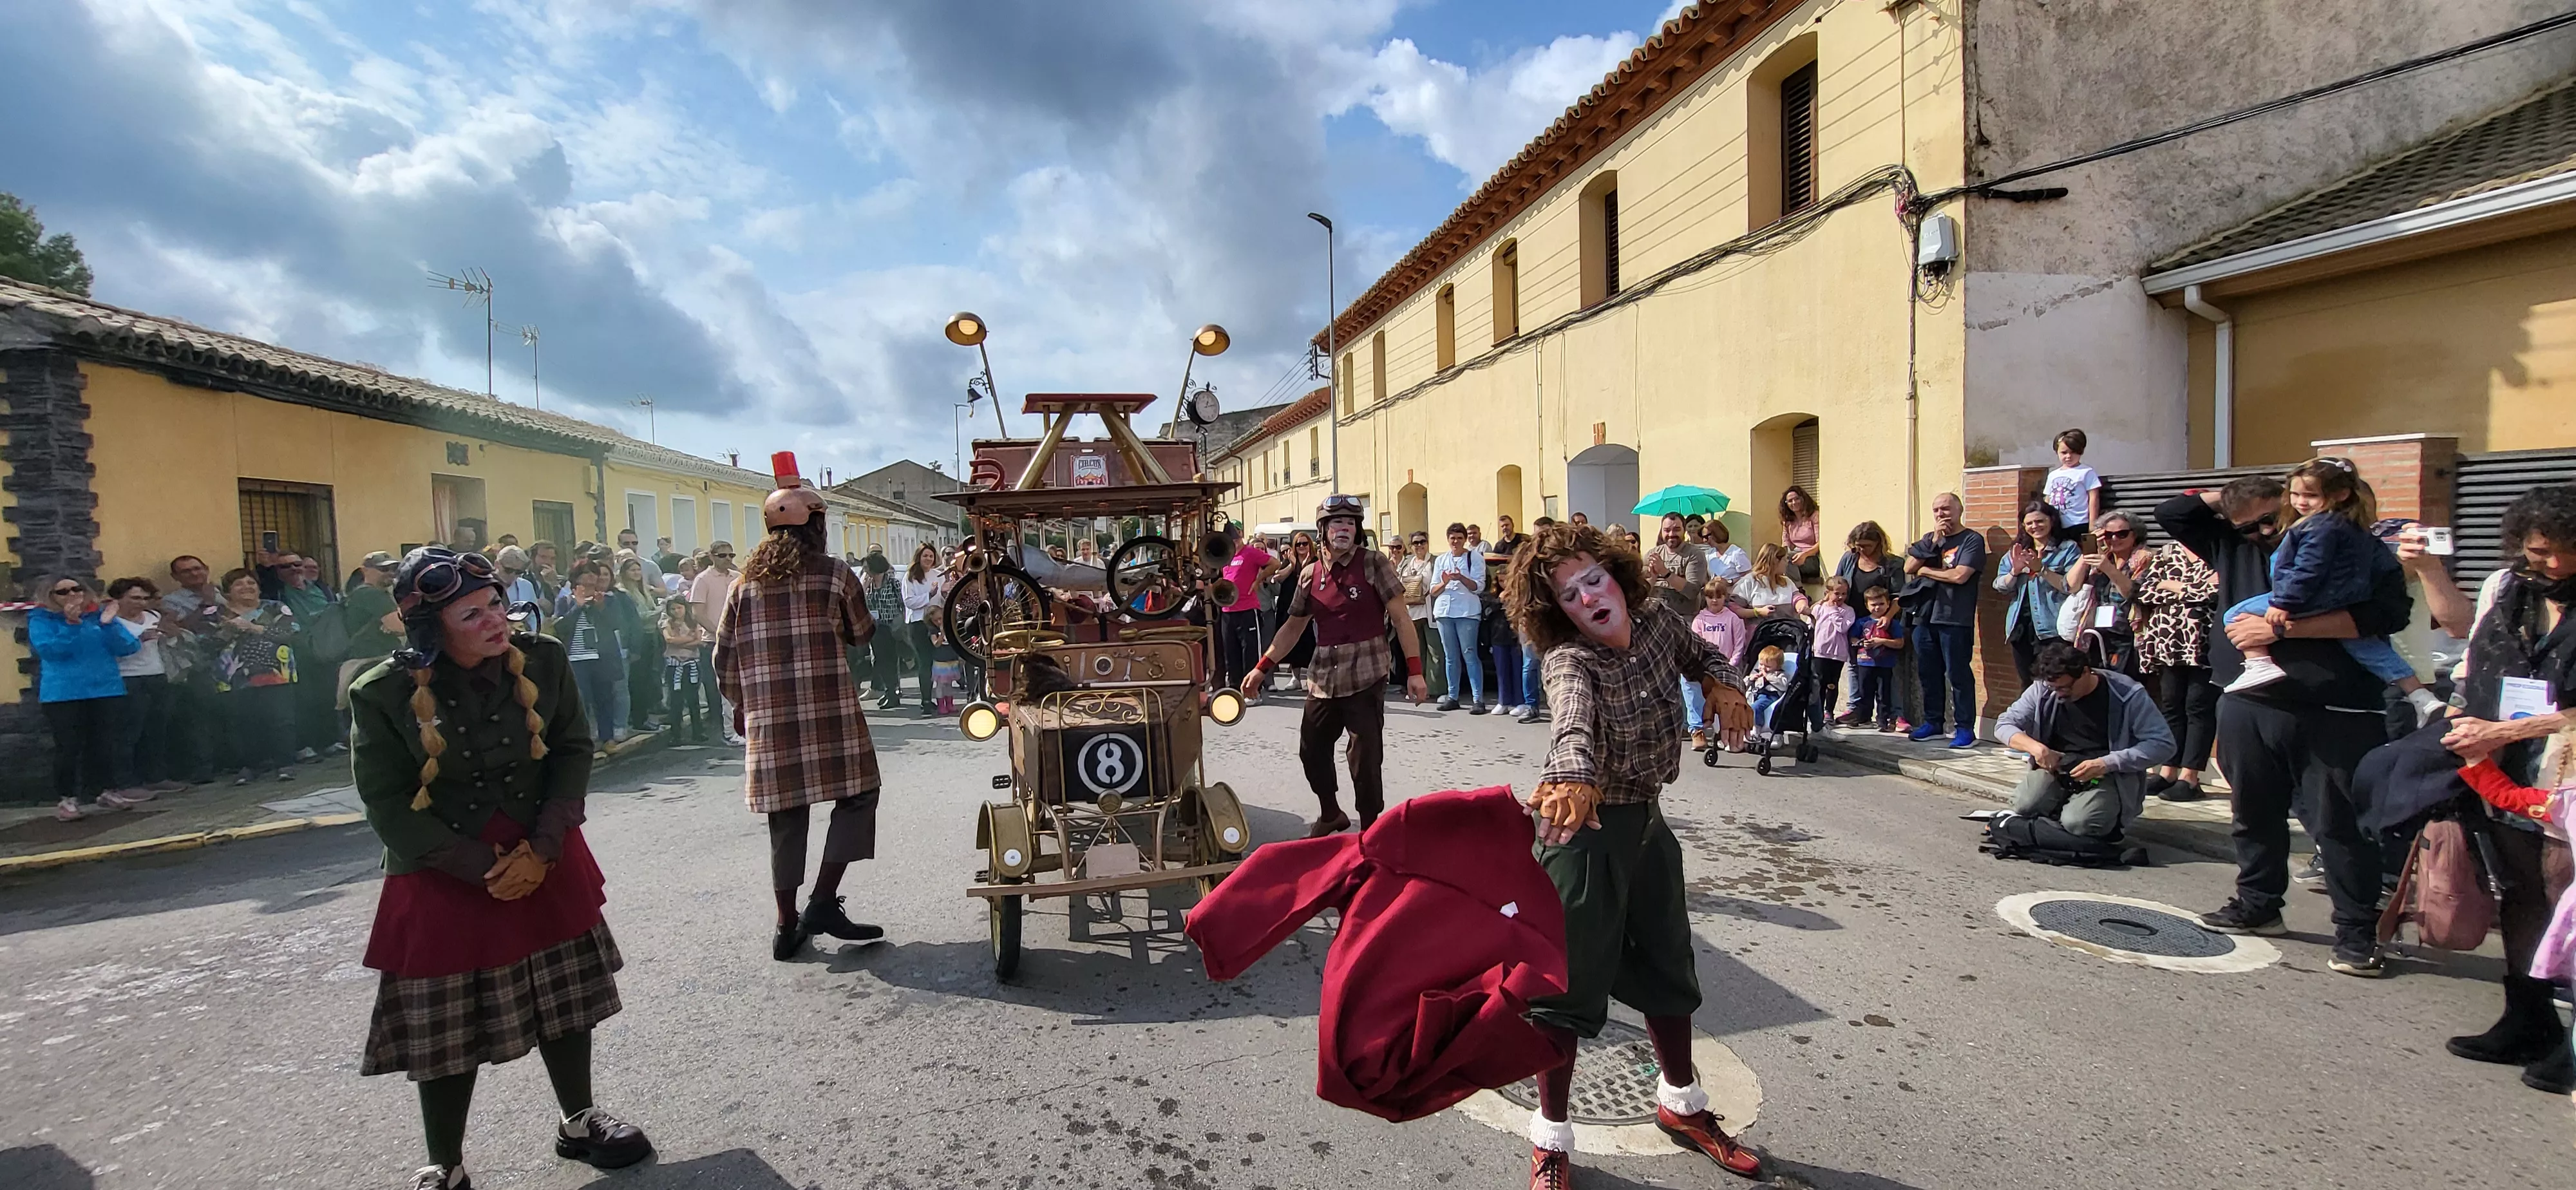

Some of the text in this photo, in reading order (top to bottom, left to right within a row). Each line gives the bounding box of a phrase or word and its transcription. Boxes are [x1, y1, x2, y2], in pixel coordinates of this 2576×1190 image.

[1078, 459, 1101, 469] CIRCUS
[1349, 587, 1358, 598] 3
[1097, 742, 1124, 784] 8
